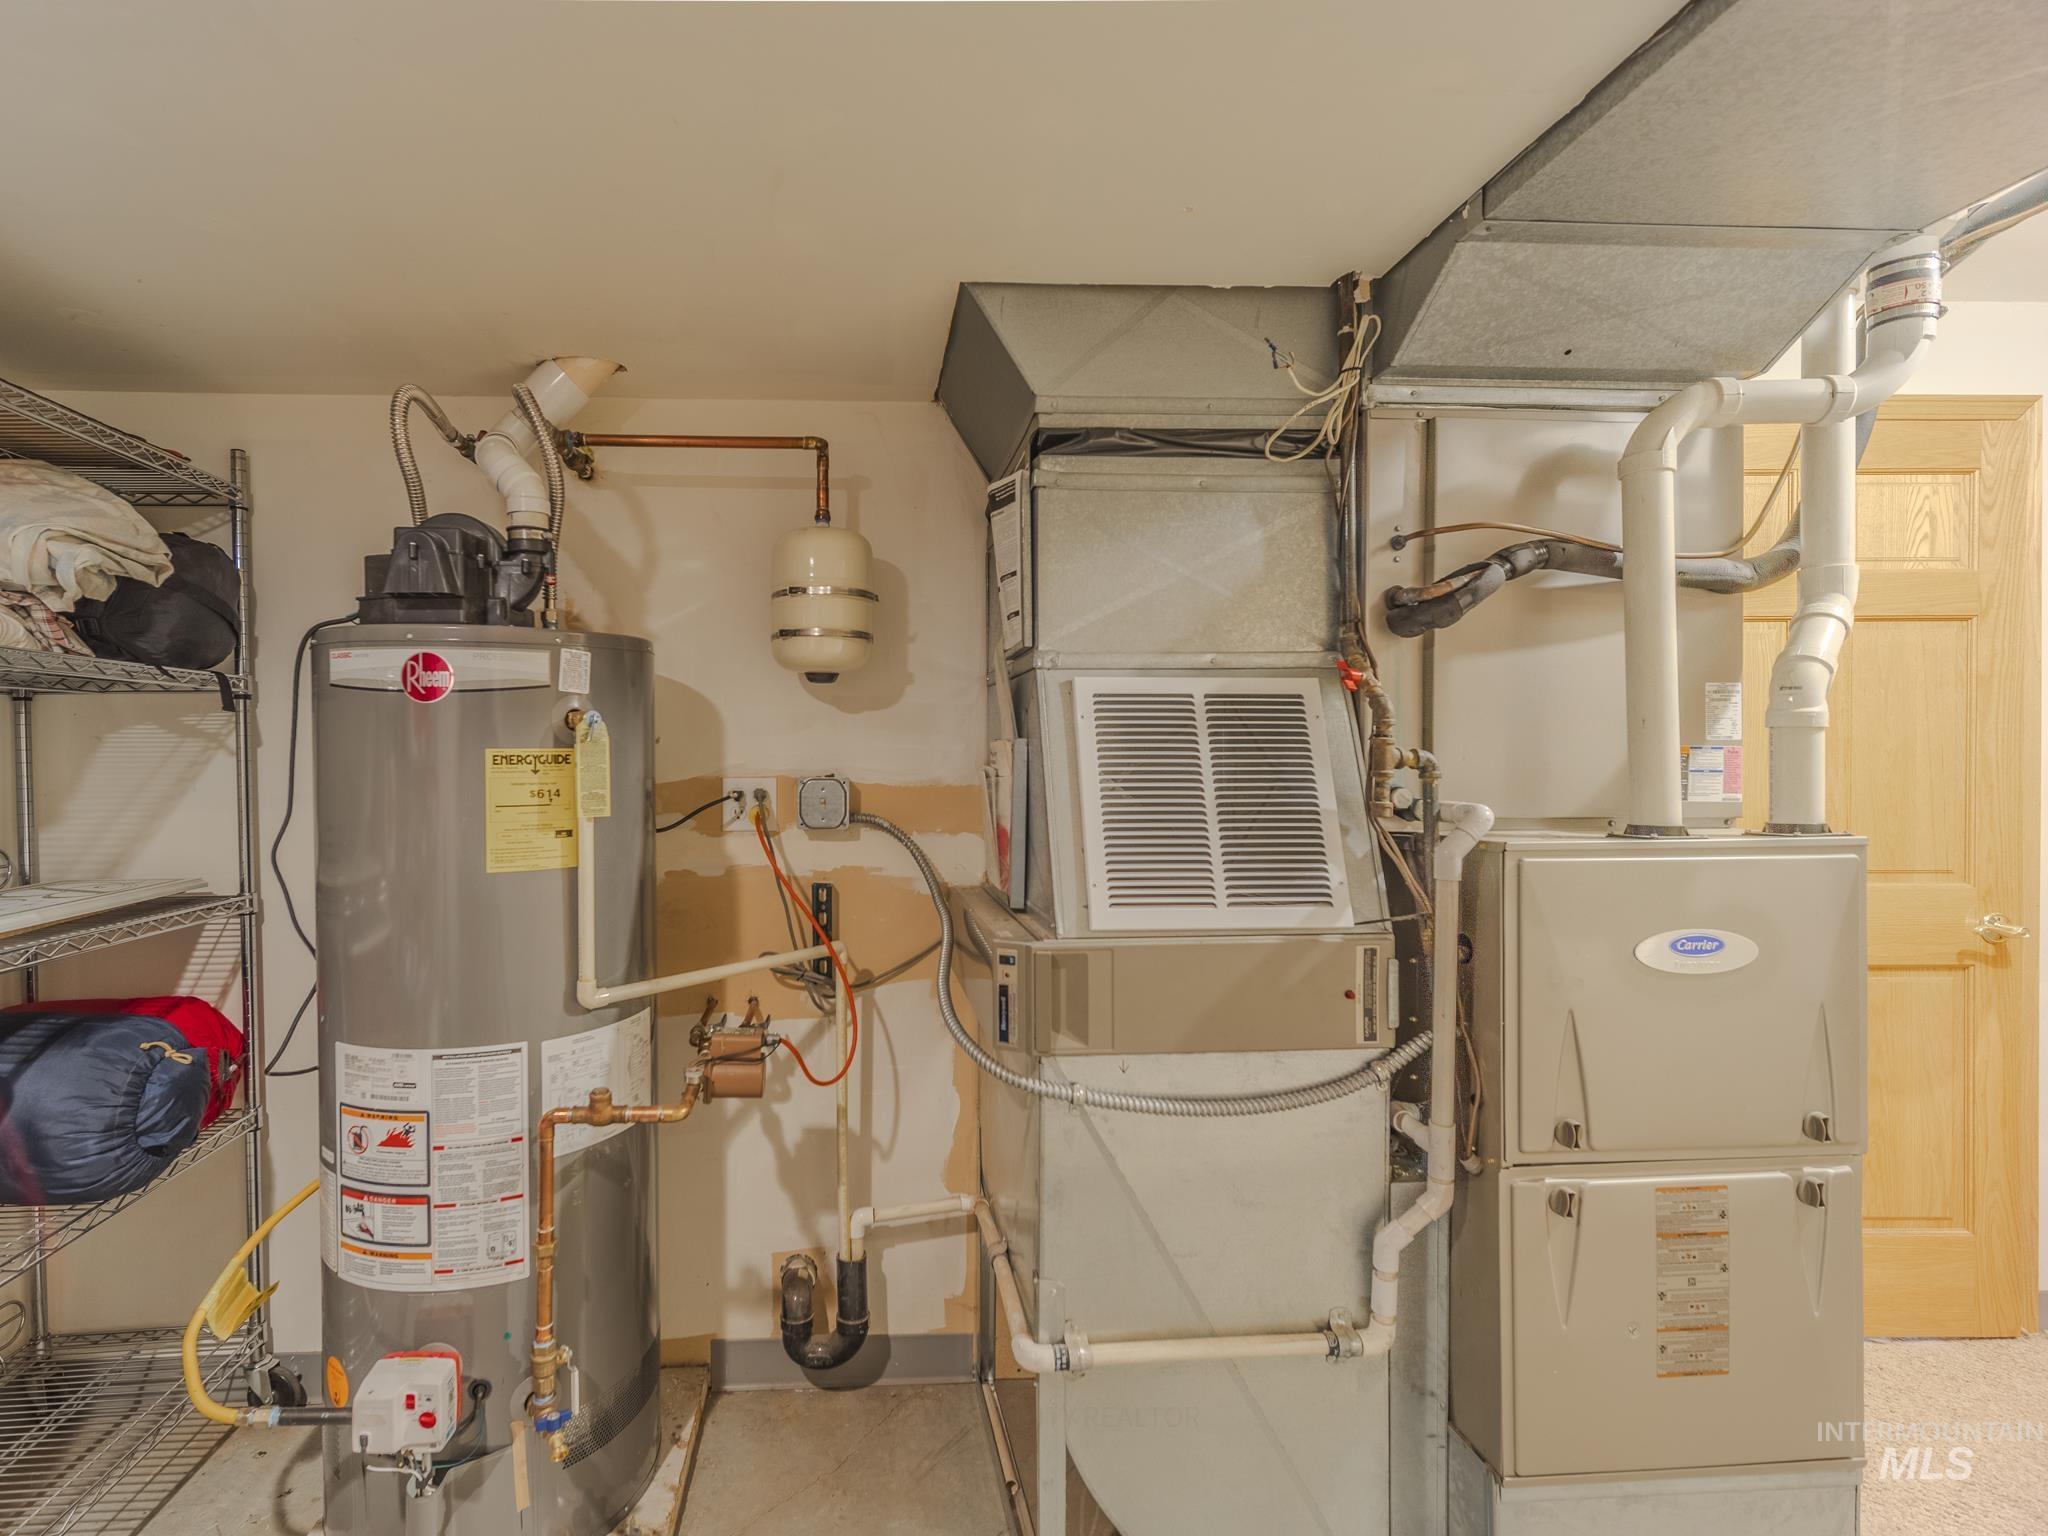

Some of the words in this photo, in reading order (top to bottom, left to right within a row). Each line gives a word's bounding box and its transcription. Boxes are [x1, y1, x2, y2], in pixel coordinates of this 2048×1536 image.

[406, 653, 450, 694] Rheem
[492, 753, 572, 767] ENERGYGUIDE
[1676, 939, 1720, 951] Carrier
